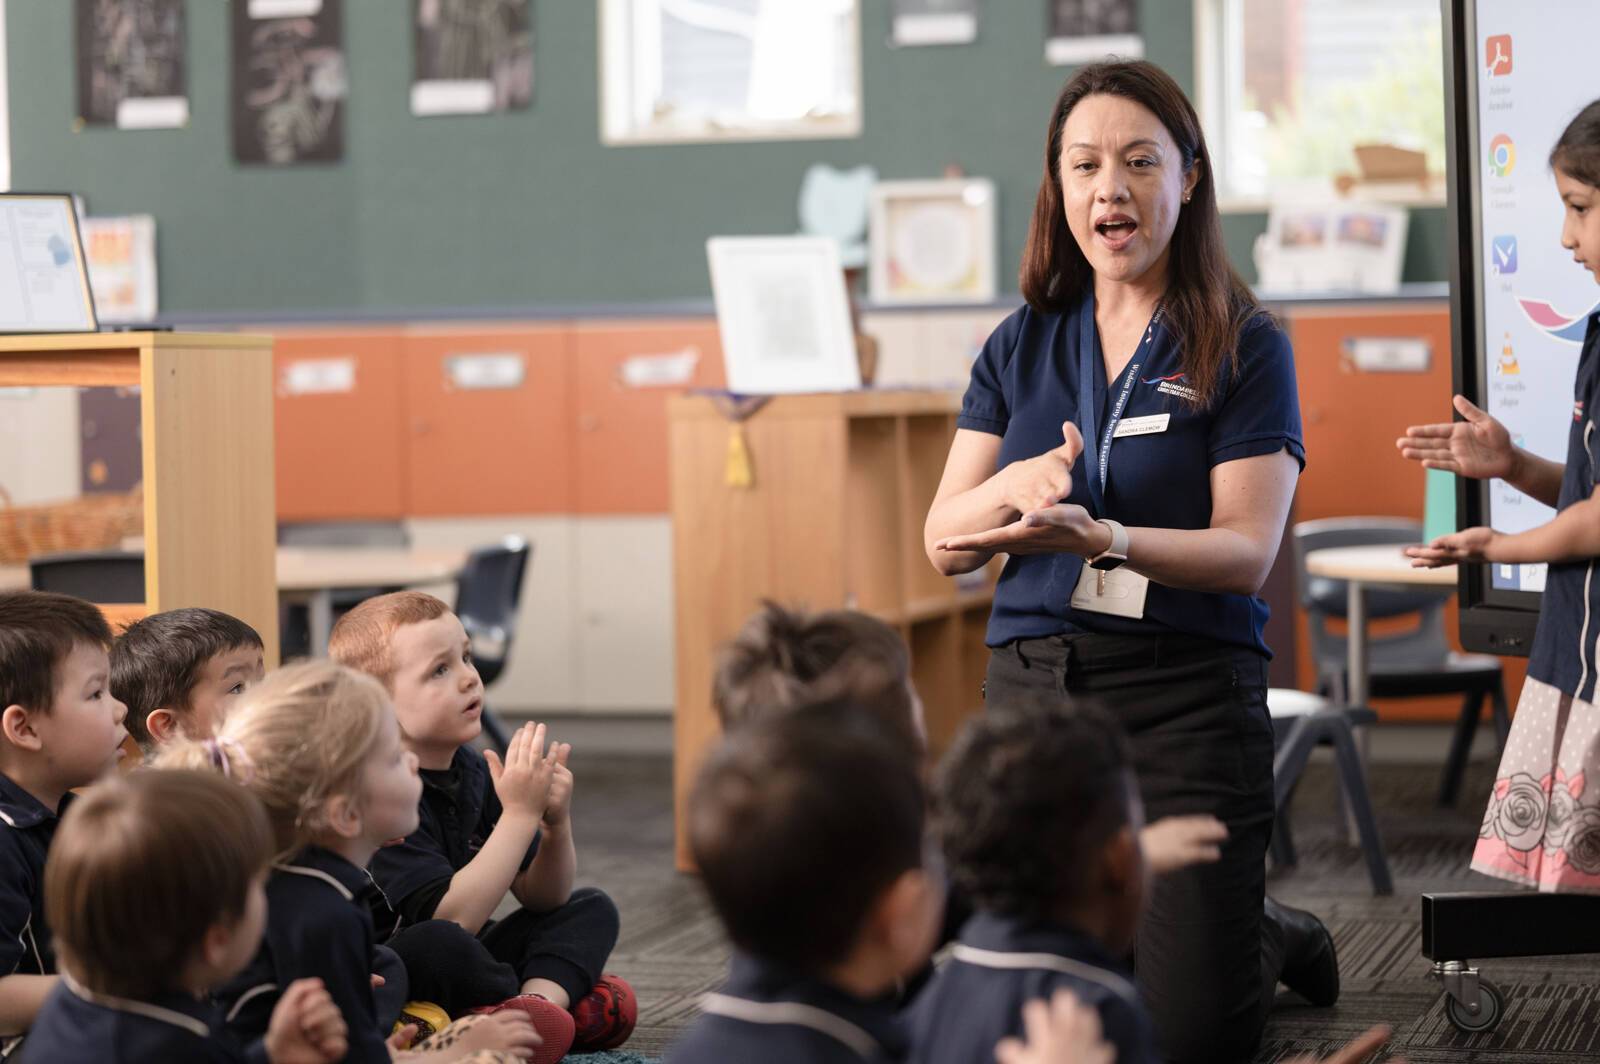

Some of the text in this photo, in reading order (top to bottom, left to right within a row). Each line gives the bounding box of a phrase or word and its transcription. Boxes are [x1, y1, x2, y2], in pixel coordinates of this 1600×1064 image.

[1100, 364, 1139, 483] Wisdom Integrity Service Excellenc
